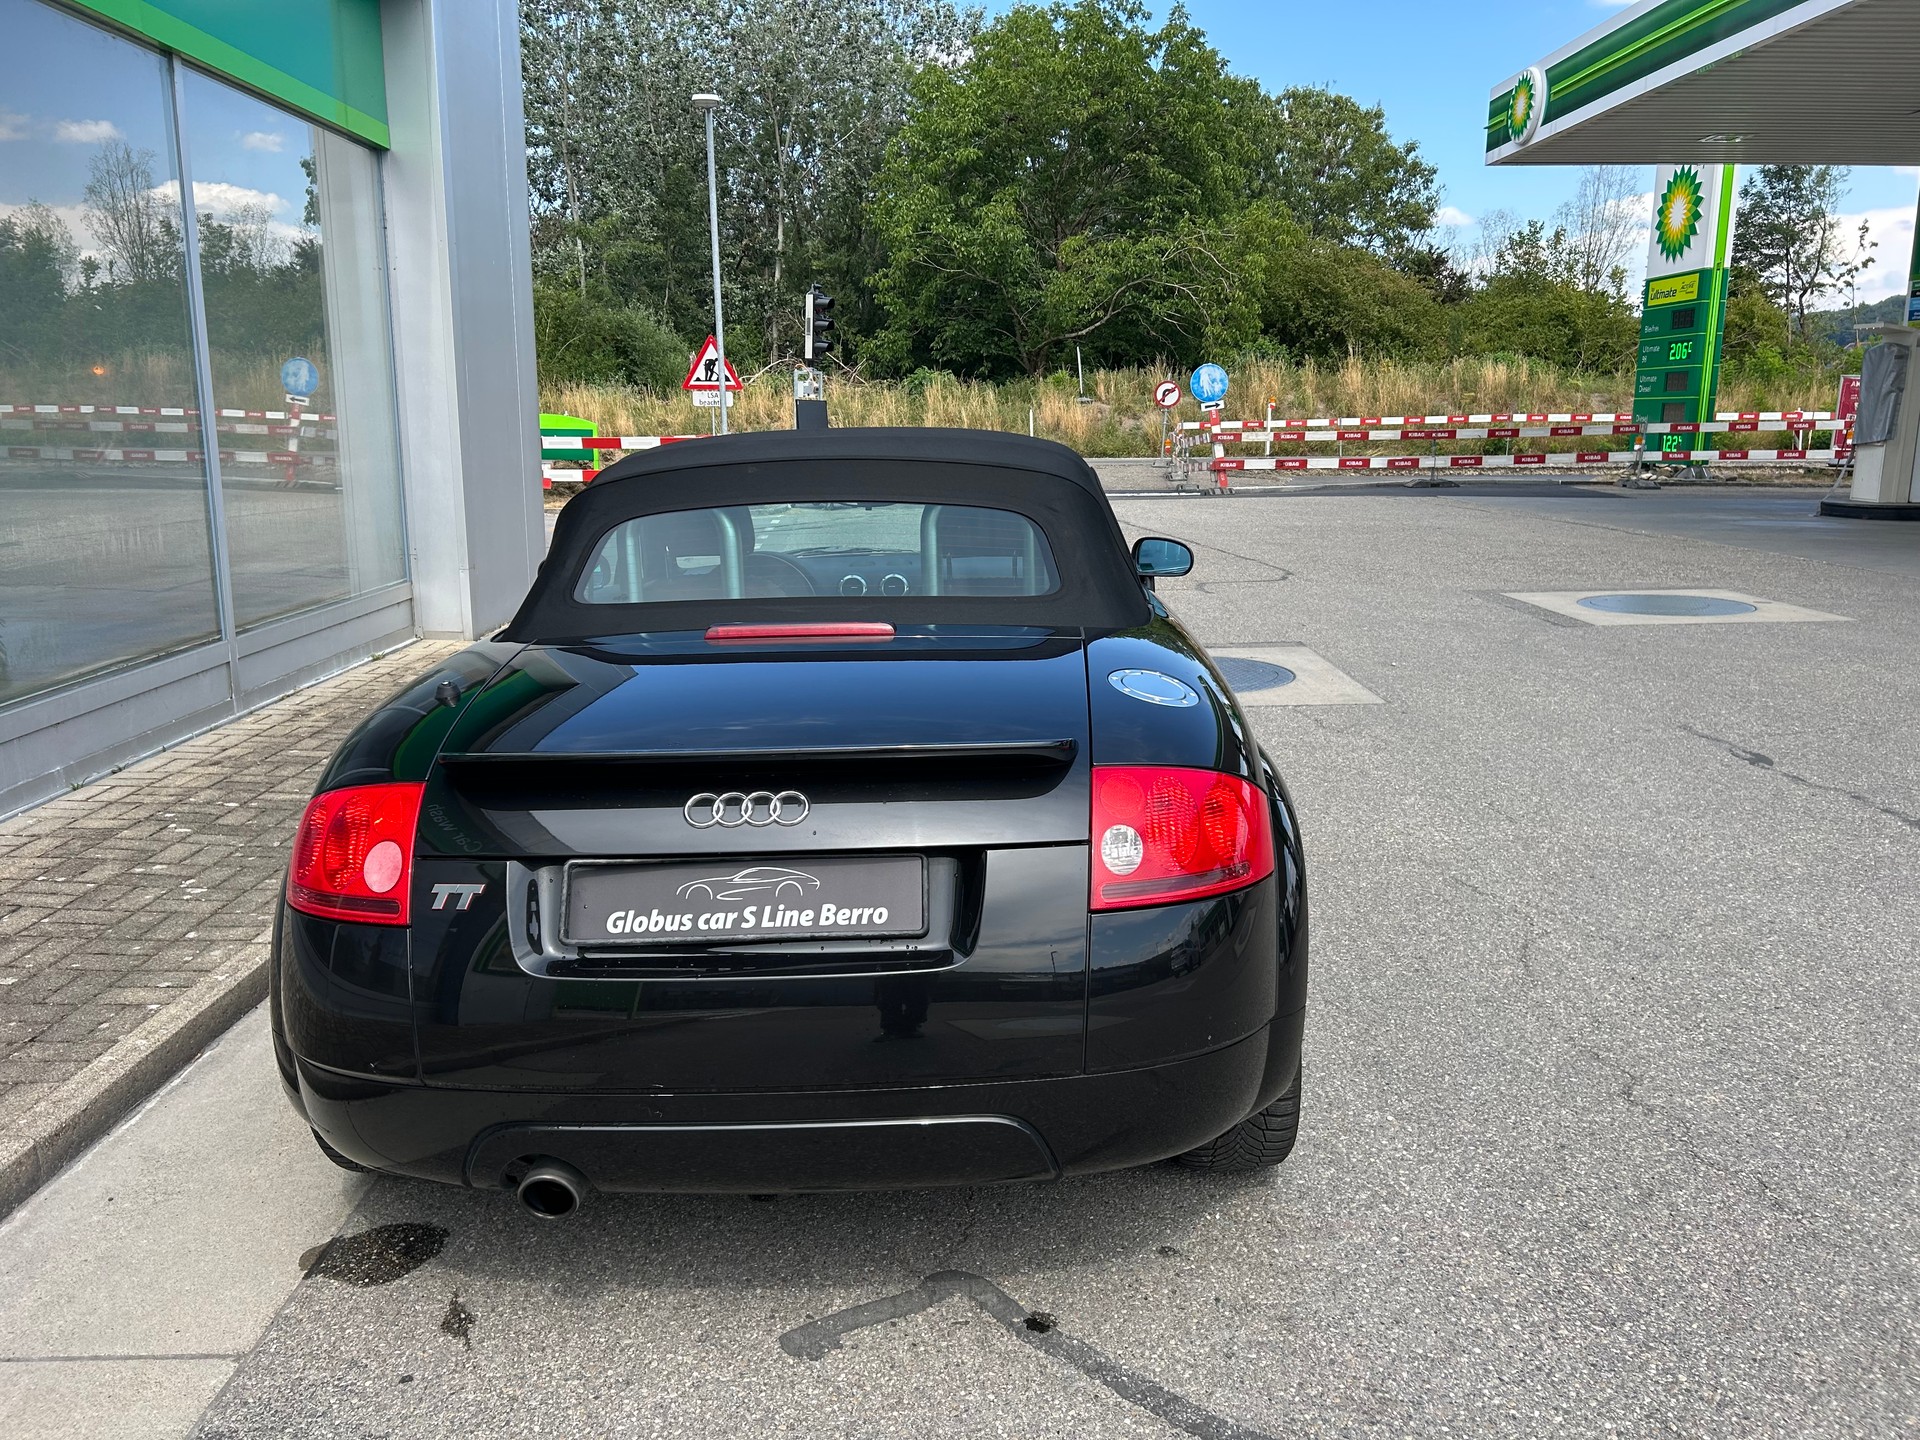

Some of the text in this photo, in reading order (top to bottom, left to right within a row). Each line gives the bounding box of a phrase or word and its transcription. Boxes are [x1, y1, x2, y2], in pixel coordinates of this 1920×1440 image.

[431, 884, 486, 910] TT
[606, 904, 889, 934] Globus car S Line Berro
